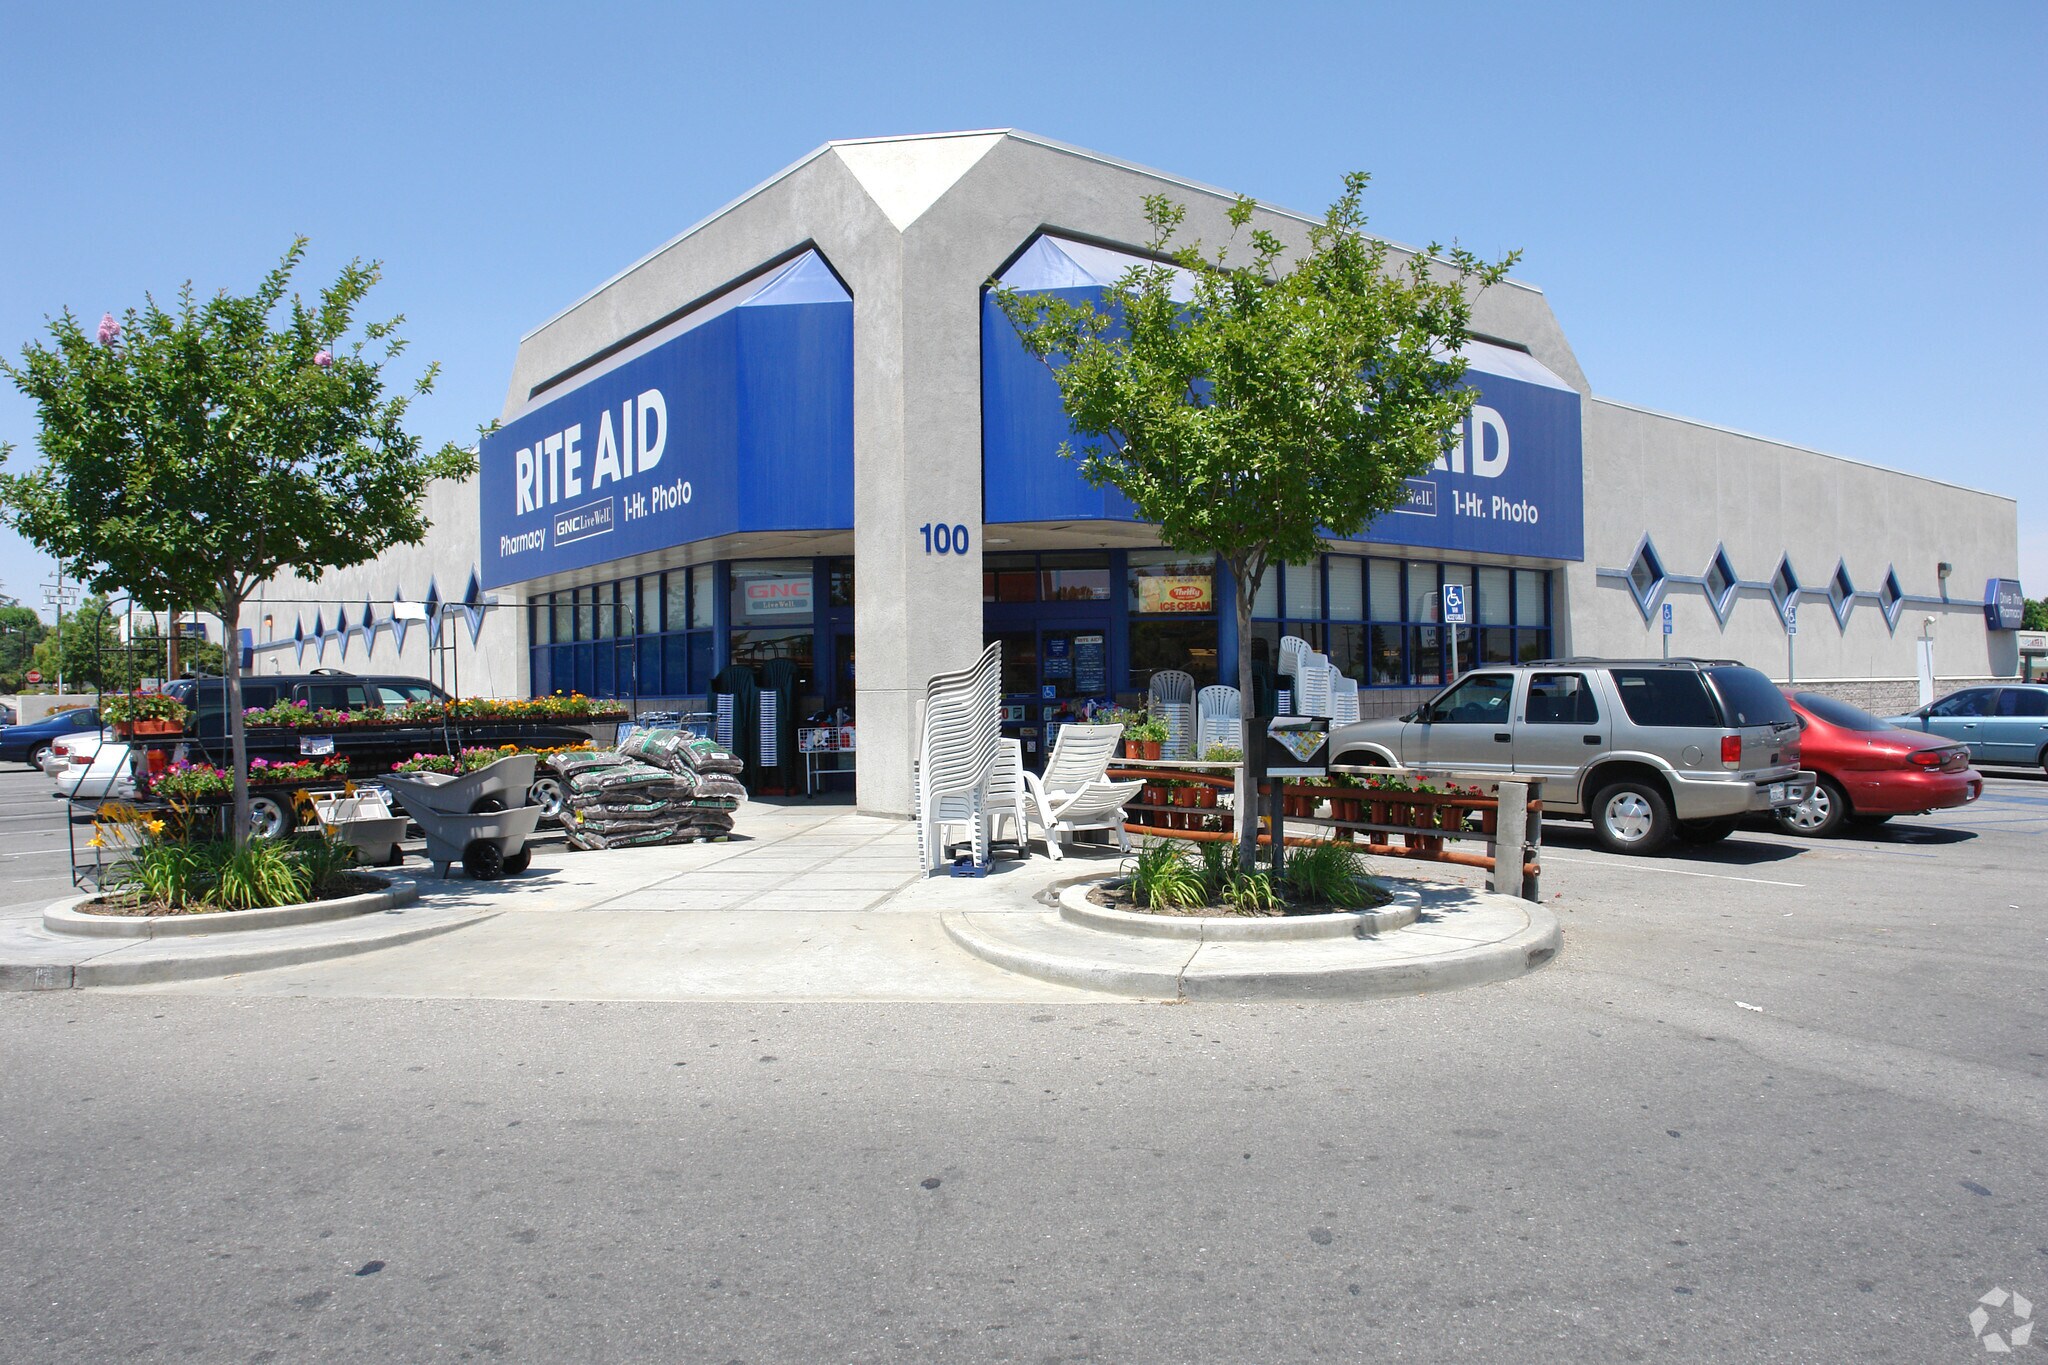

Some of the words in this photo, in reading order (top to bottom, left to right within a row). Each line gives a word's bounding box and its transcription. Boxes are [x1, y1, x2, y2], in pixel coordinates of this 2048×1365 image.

[516, 423, 582, 515] RITE
[592, 388, 667, 490] AID
[1434, 405, 1509, 478] ID
[623, 491, 648, 522] 1-Hr.
[652, 478, 692, 514] Photo
[1453, 490, 1486, 518] 1-Hr.
[1492, 496, 1538, 524] Photo
[556, 516, 580, 536] GNC
[500, 528, 546, 558] Pharmacy
[920, 523, 969, 555] 100
[747, 582, 810, 599] GNC
[1173, 587, 1201, 598] Thrifty
[2000, 592, 2012, 604] Drive
[2012, 593, 2023, 606] Thru
[1159, 601, 1176, 611] ICE
[1176, 601, 1211, 611] CREAM
[2000, 606, 2020, 619] Pharmacy
